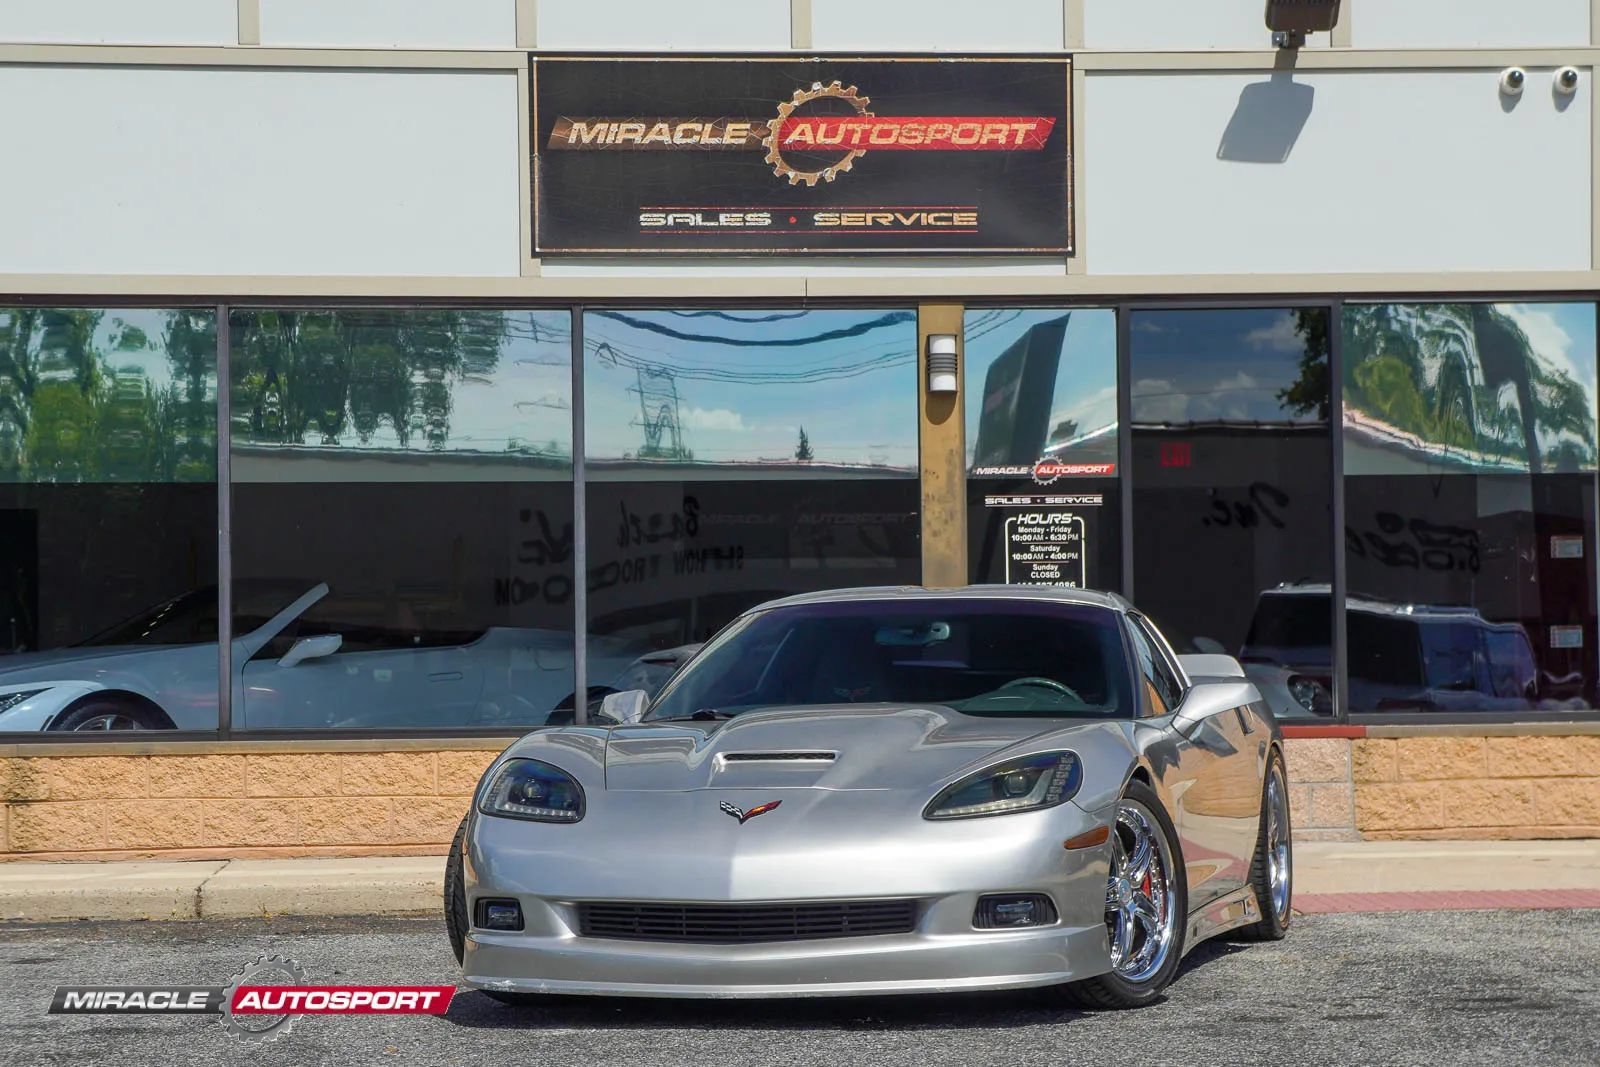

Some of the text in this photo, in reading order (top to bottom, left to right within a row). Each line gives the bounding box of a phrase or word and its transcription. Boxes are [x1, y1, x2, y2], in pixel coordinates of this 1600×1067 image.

[568, 122, 1036, 145] MIRACLE AUTOSPORT
[639, 212, 978, 226] SALES SERVICE
[976, 465, 1111, 475] MIRACLE AUTOSPORT
[985, 496, 1103, 505] SALES SERVICE
[1017, 513, 1073, 524] HOURS
[1018, 526, 1045, 534] Monday
[1050, 526, 1072, 534] Friday
[1030, 545, 1061, 553] Saturday
[1032, 563, 1059, 571] Sunday
[1030, 571, 1061, 579] CLOSED
